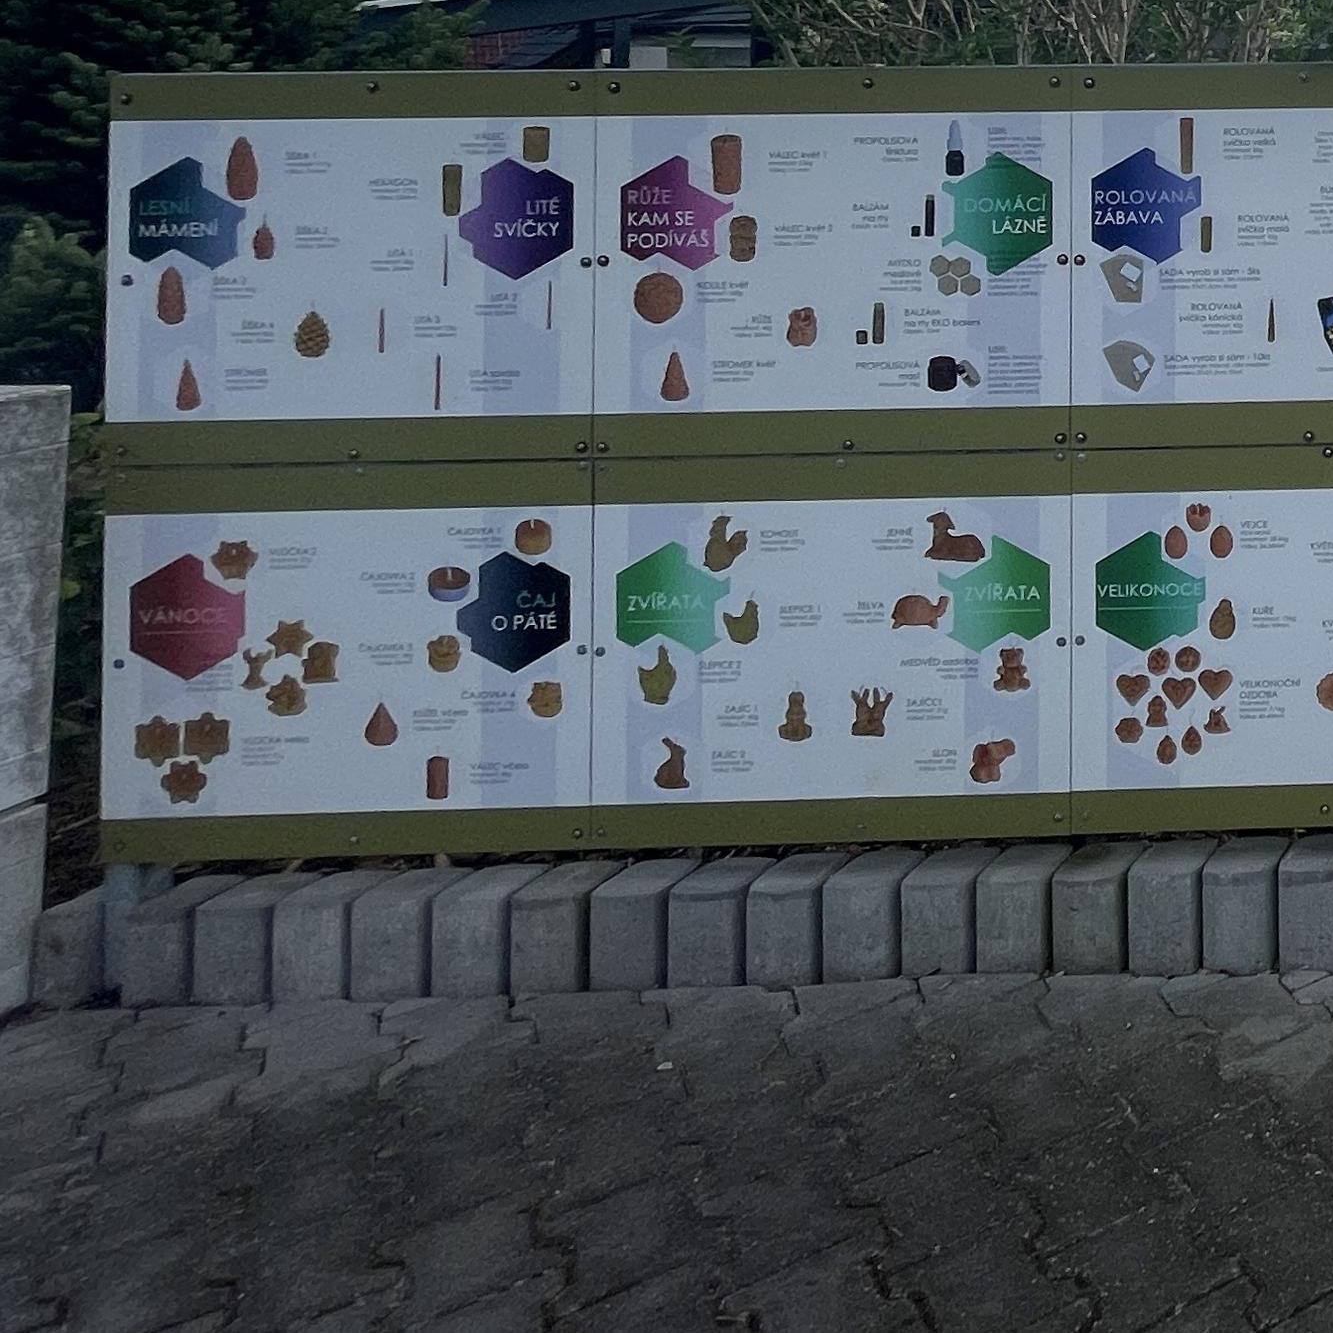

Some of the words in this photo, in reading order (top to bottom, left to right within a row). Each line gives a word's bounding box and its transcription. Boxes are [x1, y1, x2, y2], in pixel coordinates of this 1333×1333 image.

[1223, 127, 1275, 136] ROLOVANÁ
[627, 186, 672, 204] RŮŽE
[963, 193, 1046, 212] DOMÁCÍ
[1095, 188, 1197, 205] ROLOVANÁ
[140, 197, 191, 215] LESNÍ
[526, 196, 560, 215] LITÉ
[627, 211, 669, 226] KAM
[674, 211, 694, 225] SE
[992, 215, 1047, 234] LÁZNĚ
[1094, 209, 1164, 225] ZÁBAVA
[1238, 214, 1289, 222] ROLOVANÁ
[138, 219, 218, 237] MÁMENÍ
[493, 218, 560, 238] SVÍČKY
[627, 229, 709, 248] PODÍVÁŠ
[1160, 268, 1184, 276] SADA
[1190, 302, 1242, 311] ROLOVANÁ
[965, 583, 1041, 602] ZVÍŘATA
[1097, 583, 1200, 597] VELIKONOCE
[517, 591, 556, 608] ČAJ
[627, 591, 705, 611] ZVÍŘATA
[139, 607, 228, 624] VÁNOCE
[491, 616, 507, 631] O
[513, 612, 557, 630] PÁTÉ
